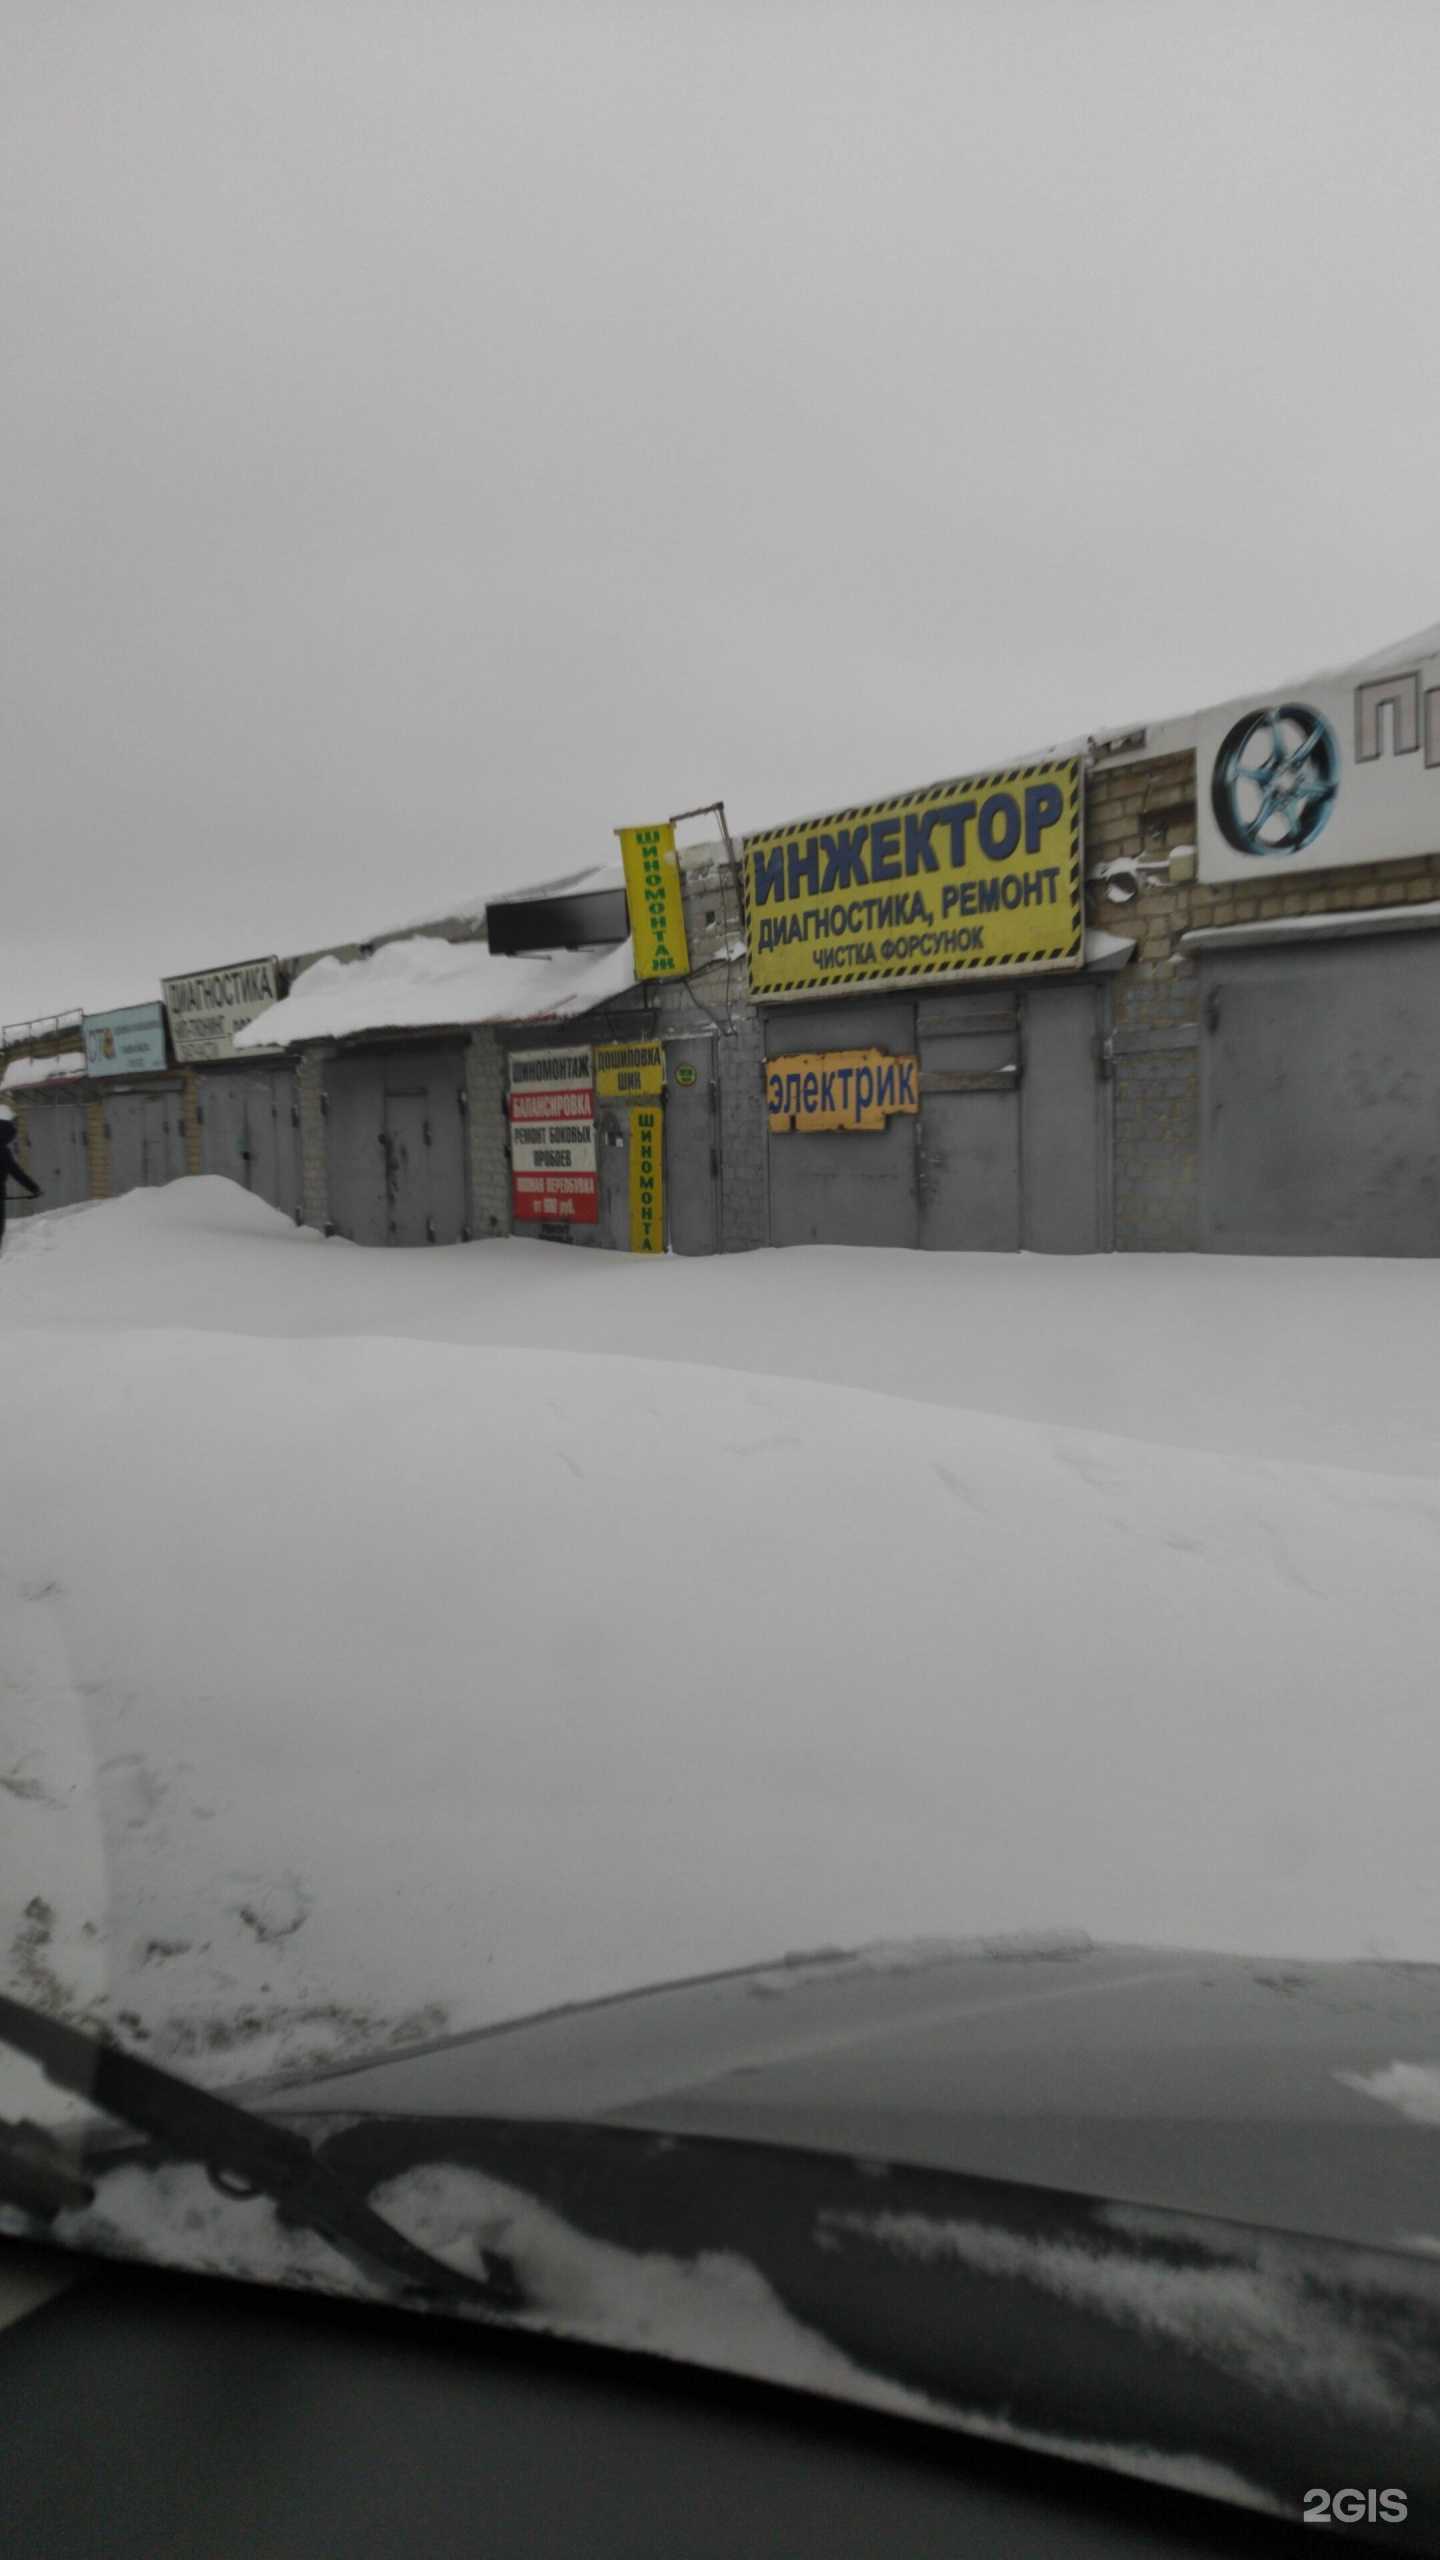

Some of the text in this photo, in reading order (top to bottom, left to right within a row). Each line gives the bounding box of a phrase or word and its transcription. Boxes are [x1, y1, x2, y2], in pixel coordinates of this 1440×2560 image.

[1354, 668, 1440, 770] П
[753, 783, 1064, 906] ИНЖЕКТОР
[636, 831, 675, 971] ШИНОМОНТАЖ
[758, 868, 1061, 954] ДИАГНОСТИКА, РЕМОНТ
[813, 926, 984, 970] ЧИСТКА ФОРСУНОК
[167, 966, 273, 1014] ДИАГНОСТИКА
[512, 1055, 590, 1083] ШИНОМОНТАЖ
[512, 1093, 592, 1119] БАЛАНСИРОВКА
[769, 1064, 915, 1123] электрик
[514, 1126, 592, 1145] РЕМОНТ БОКОВЫХ
[534, 1150, 572, 1168] ПРОБОЕВ
